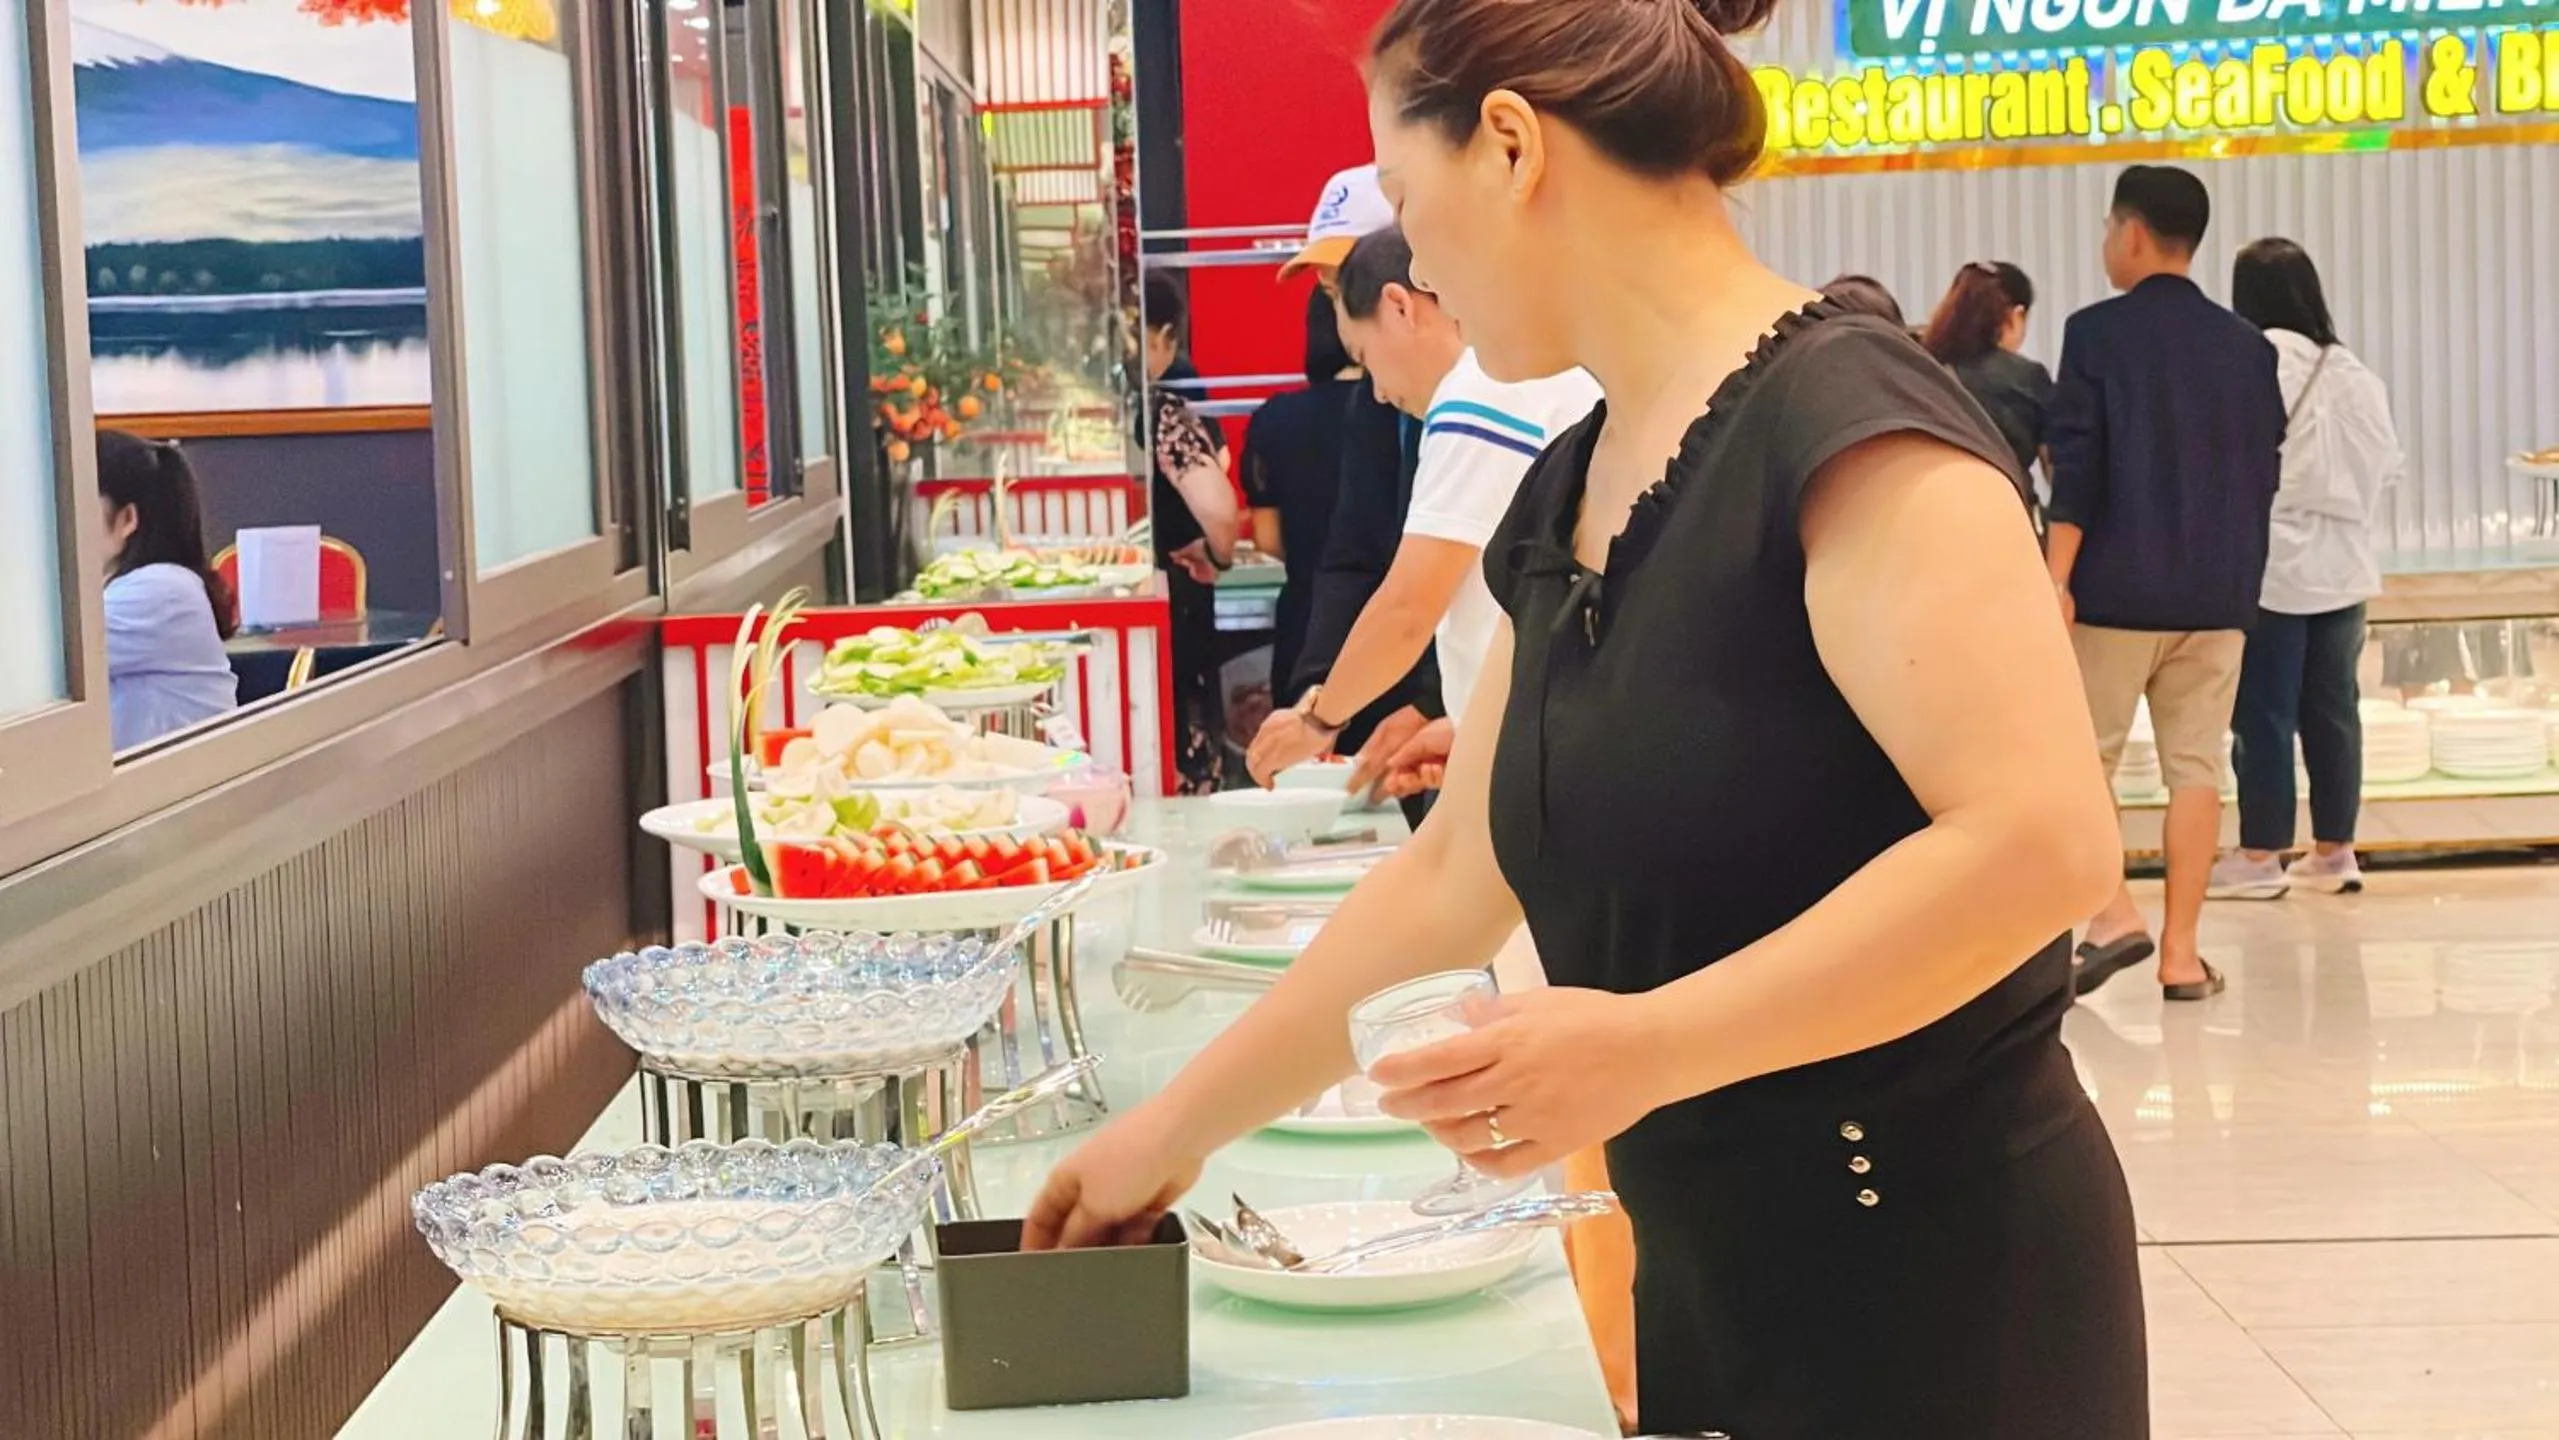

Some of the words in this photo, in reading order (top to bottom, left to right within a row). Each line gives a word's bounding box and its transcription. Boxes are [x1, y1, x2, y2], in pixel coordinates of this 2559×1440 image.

[1747, 55, 2090, 149] Restaurant
[2130, 38, 2404, 130] SeaFood
[2425, 34, 2477, 118] &
